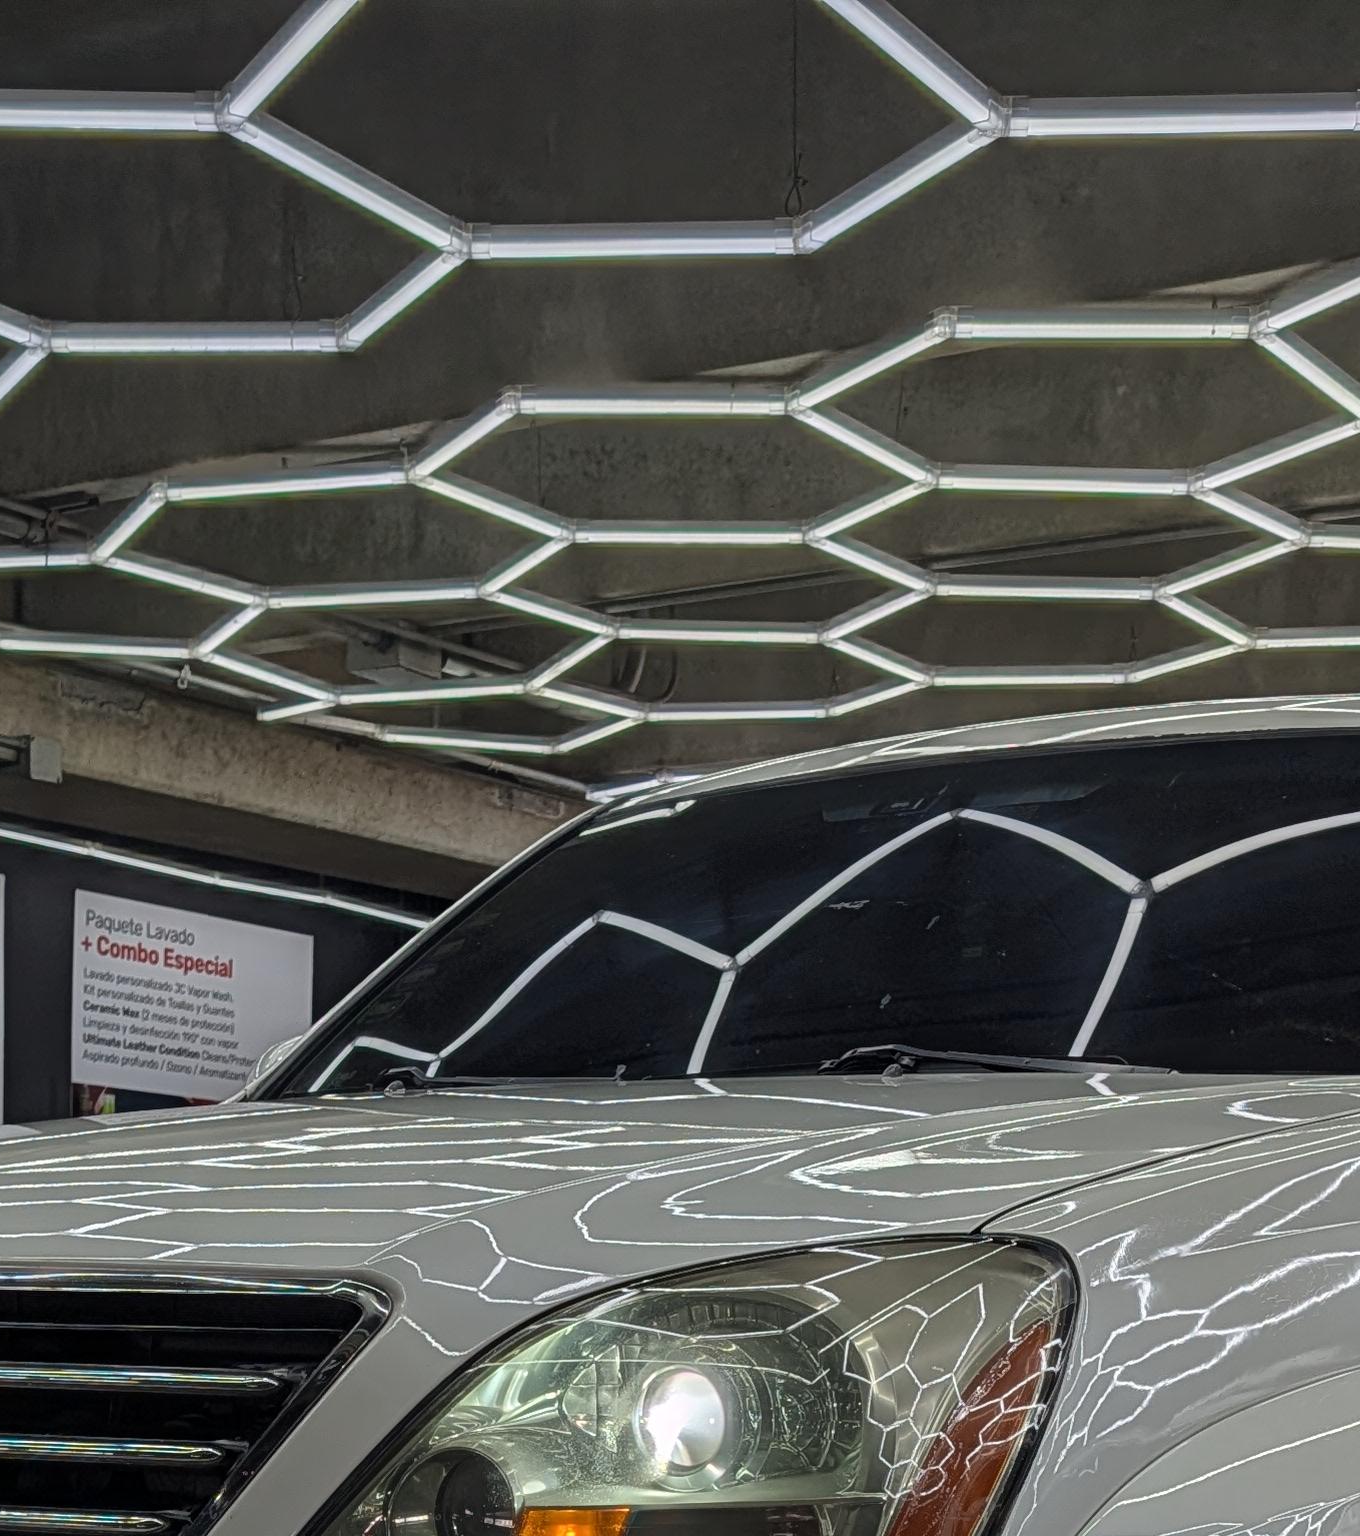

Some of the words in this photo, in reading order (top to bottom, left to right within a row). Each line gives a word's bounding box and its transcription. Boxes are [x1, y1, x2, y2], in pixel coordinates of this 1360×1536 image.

[86, 909, 143, 936] Paquete
[147, 921, 195, 946] Lavado
[97, 936, 159, 965] Combo
[164, 948, 233, 978] Especial
[84, 968, 114, 984] Lavado
[156, 997, 166, 1007] de
[83, 1000, 121, 1016] Ceramic
[122, 1007, 139, 1018] Wax
[151, 1013, 177, 1025] meses
[123, 1039, 157, 1053] Leather
[82, 1050, 120, 1066] Aspirado
